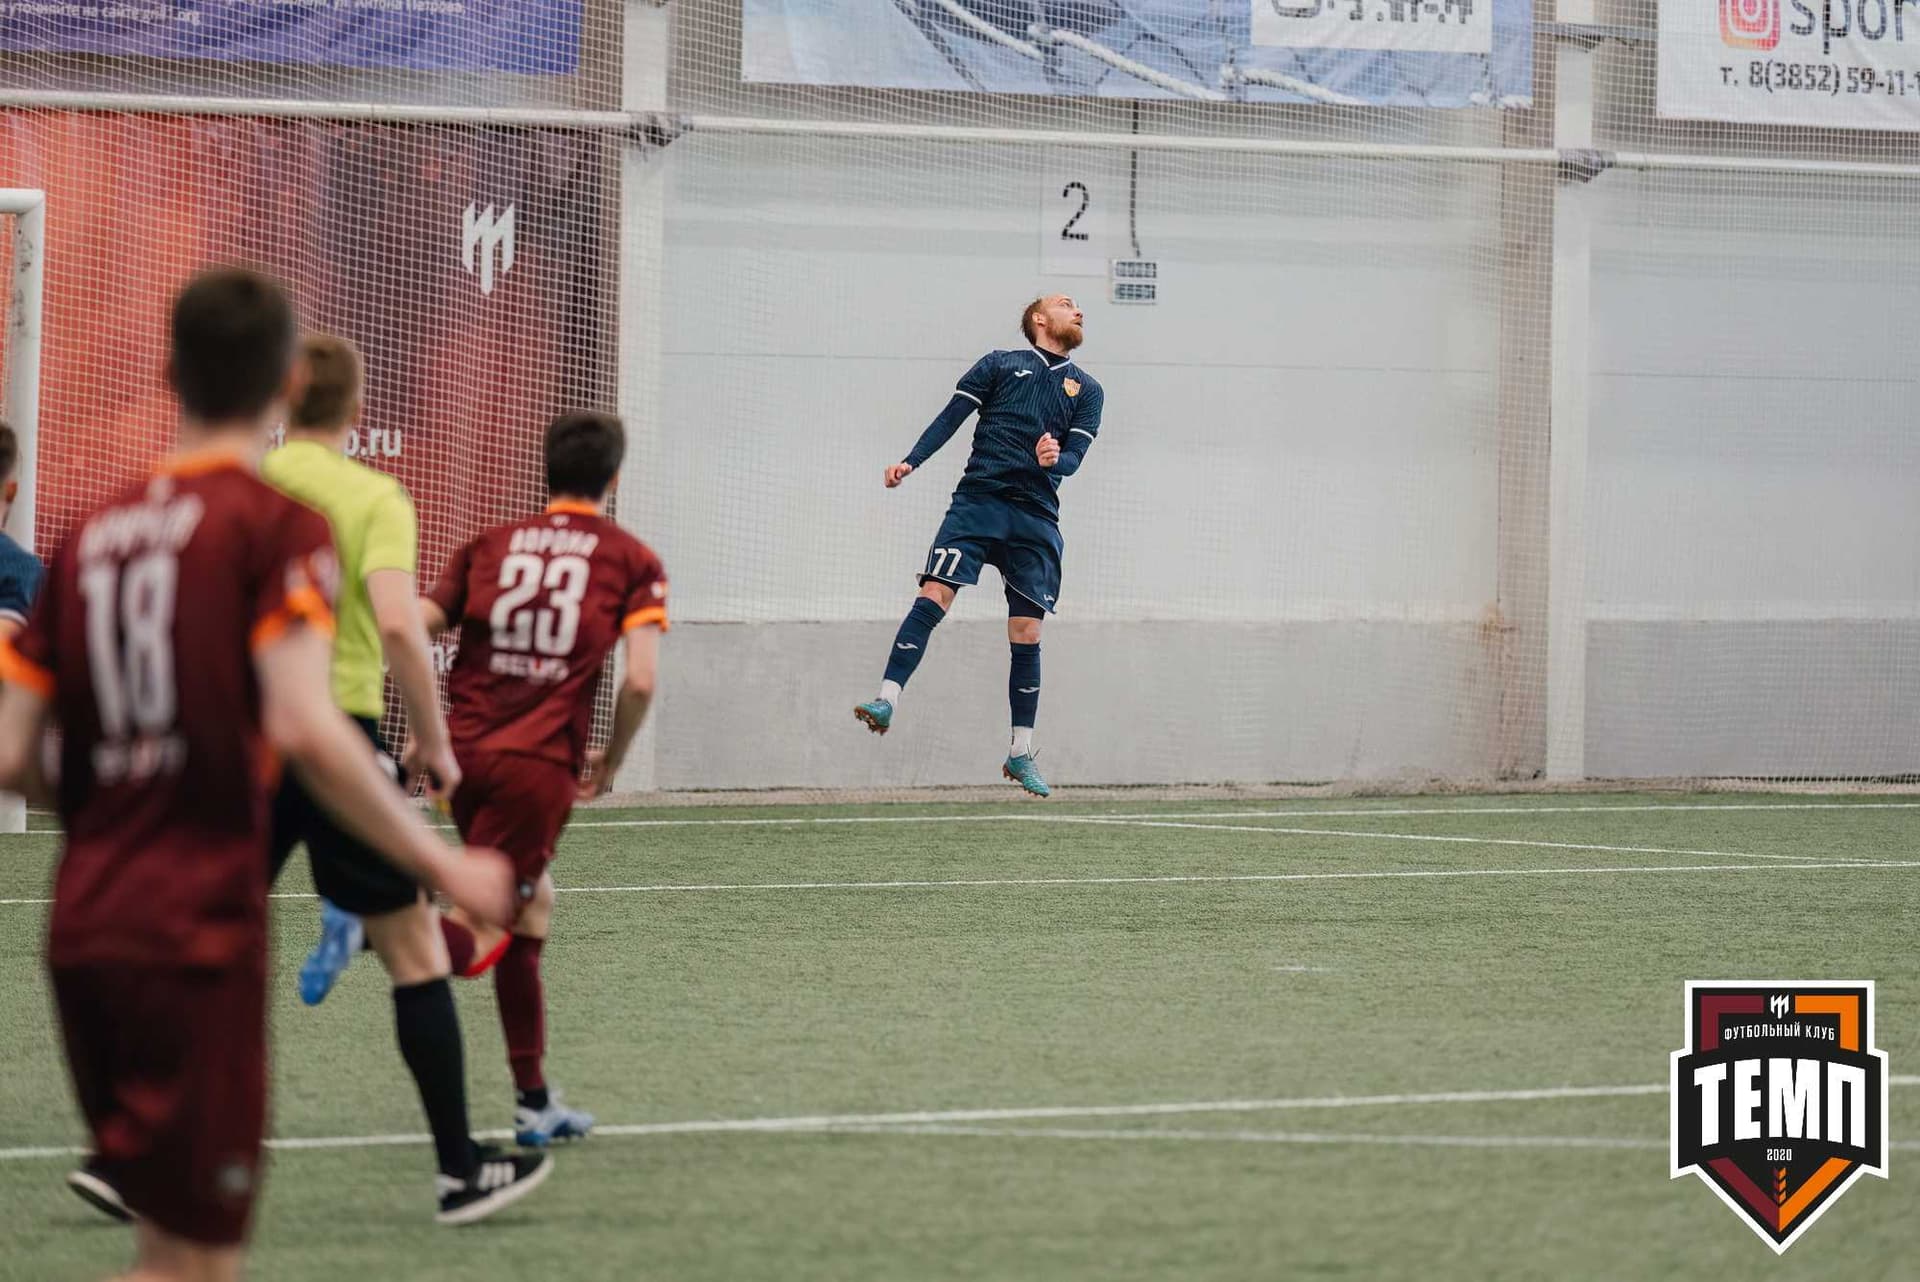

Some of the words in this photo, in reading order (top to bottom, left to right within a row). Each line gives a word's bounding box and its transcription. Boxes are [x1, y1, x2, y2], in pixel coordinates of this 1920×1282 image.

[1750, 60, 1840, 96] 8(3852)
[1062, 182, 1089, 240] 2
[932, 548, 962, 577] 77
[490, 553, 590, 656] 23
[78, 554, 179, 738] 18
